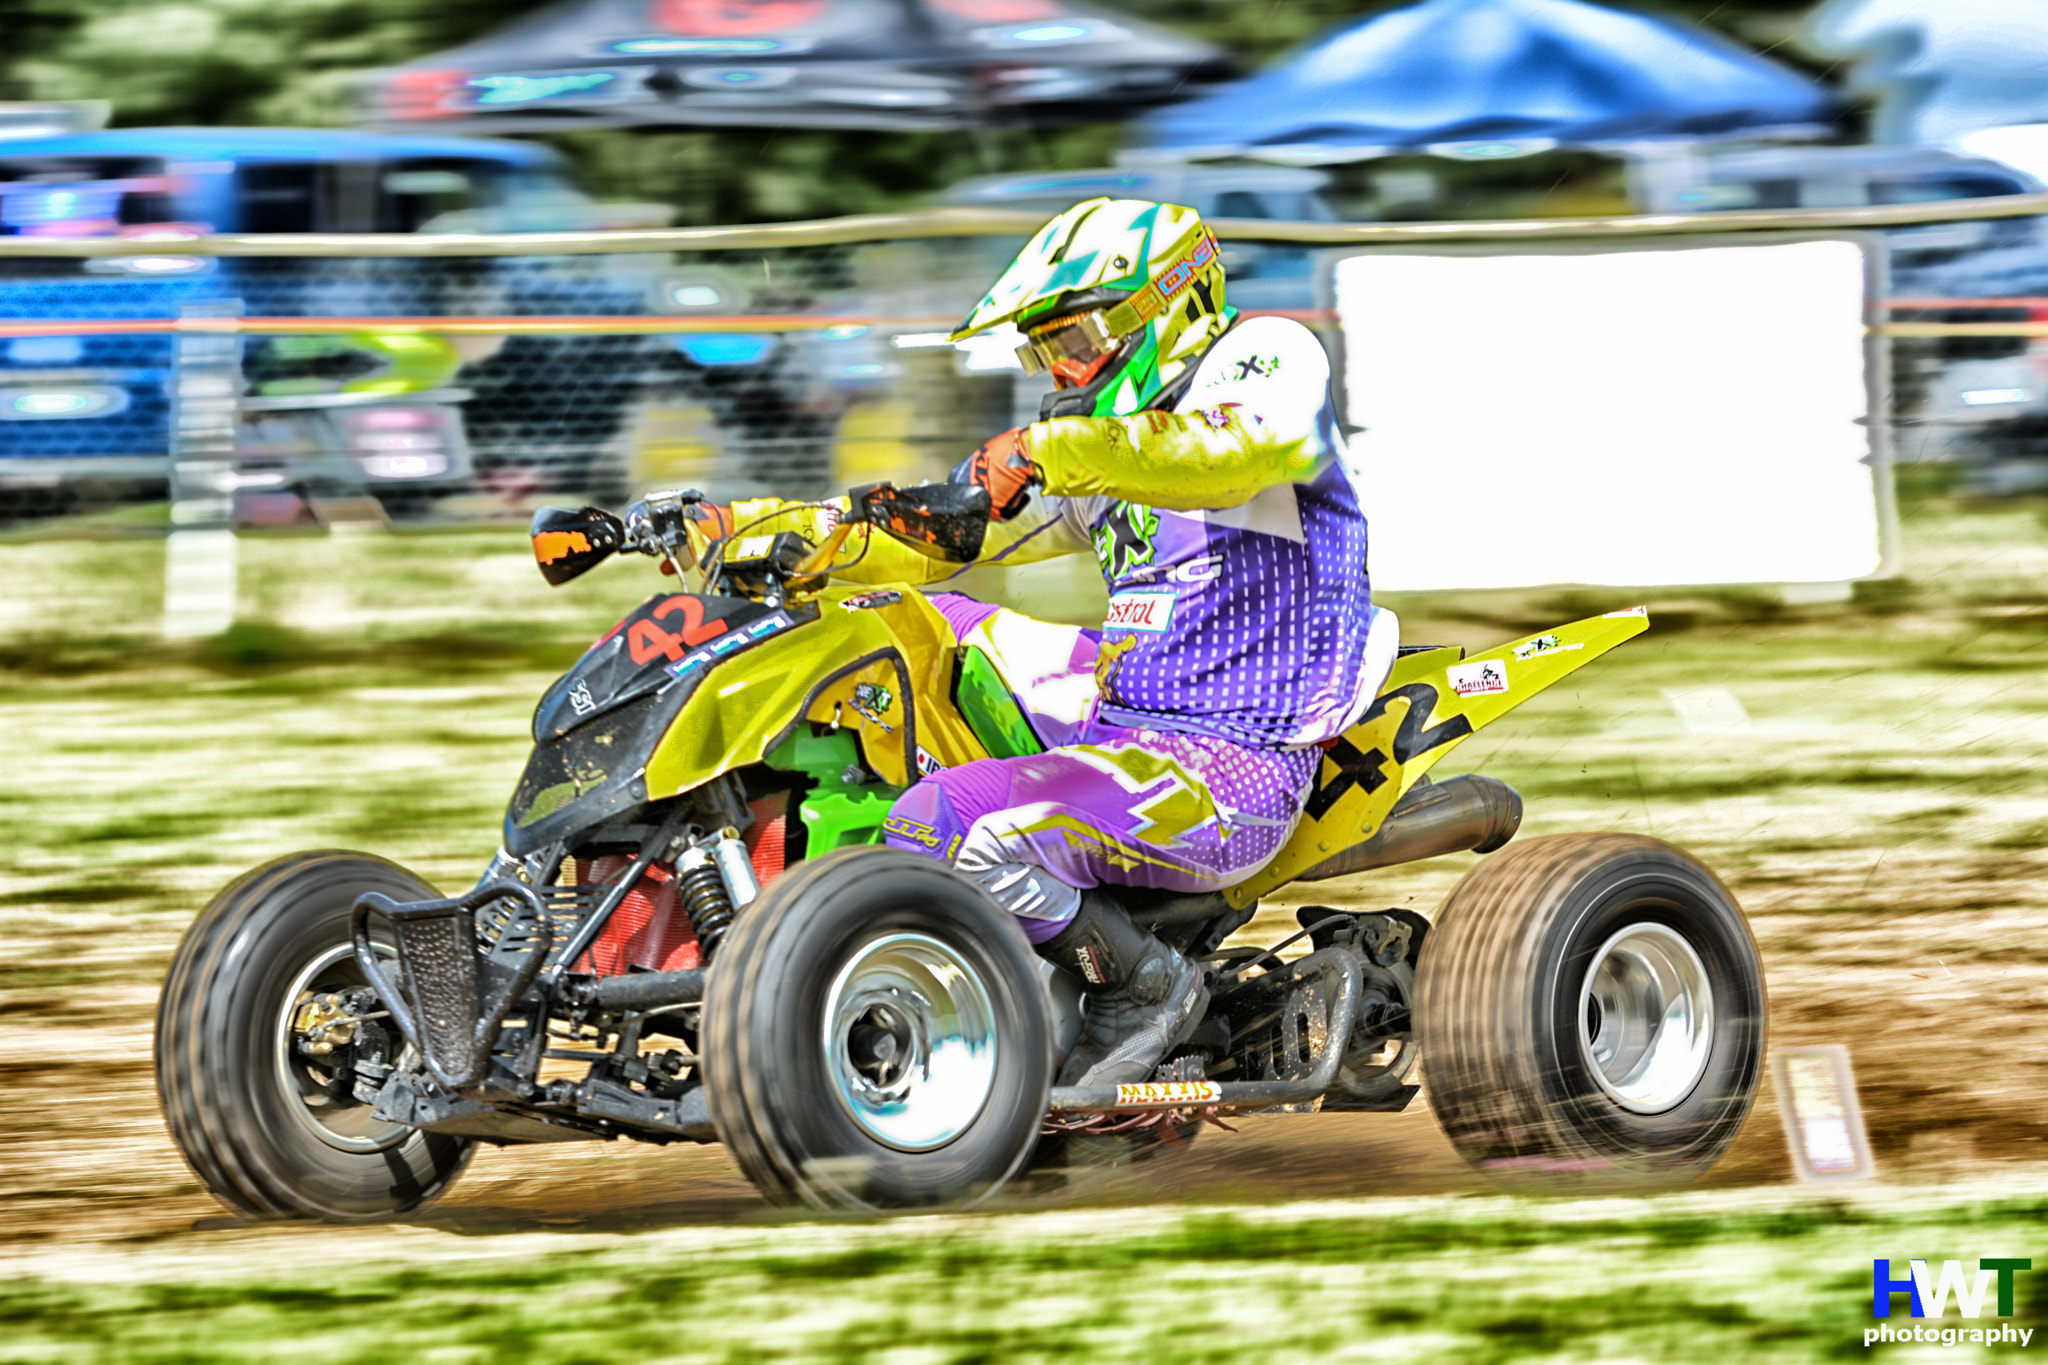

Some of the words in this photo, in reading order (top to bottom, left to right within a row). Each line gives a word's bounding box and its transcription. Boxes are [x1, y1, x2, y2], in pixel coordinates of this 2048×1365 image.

[627, 595, 729, 666] 42
[1303, 683, 1475, 823] 42
[1119, 1082, 1214, 1104] MAXXIS
